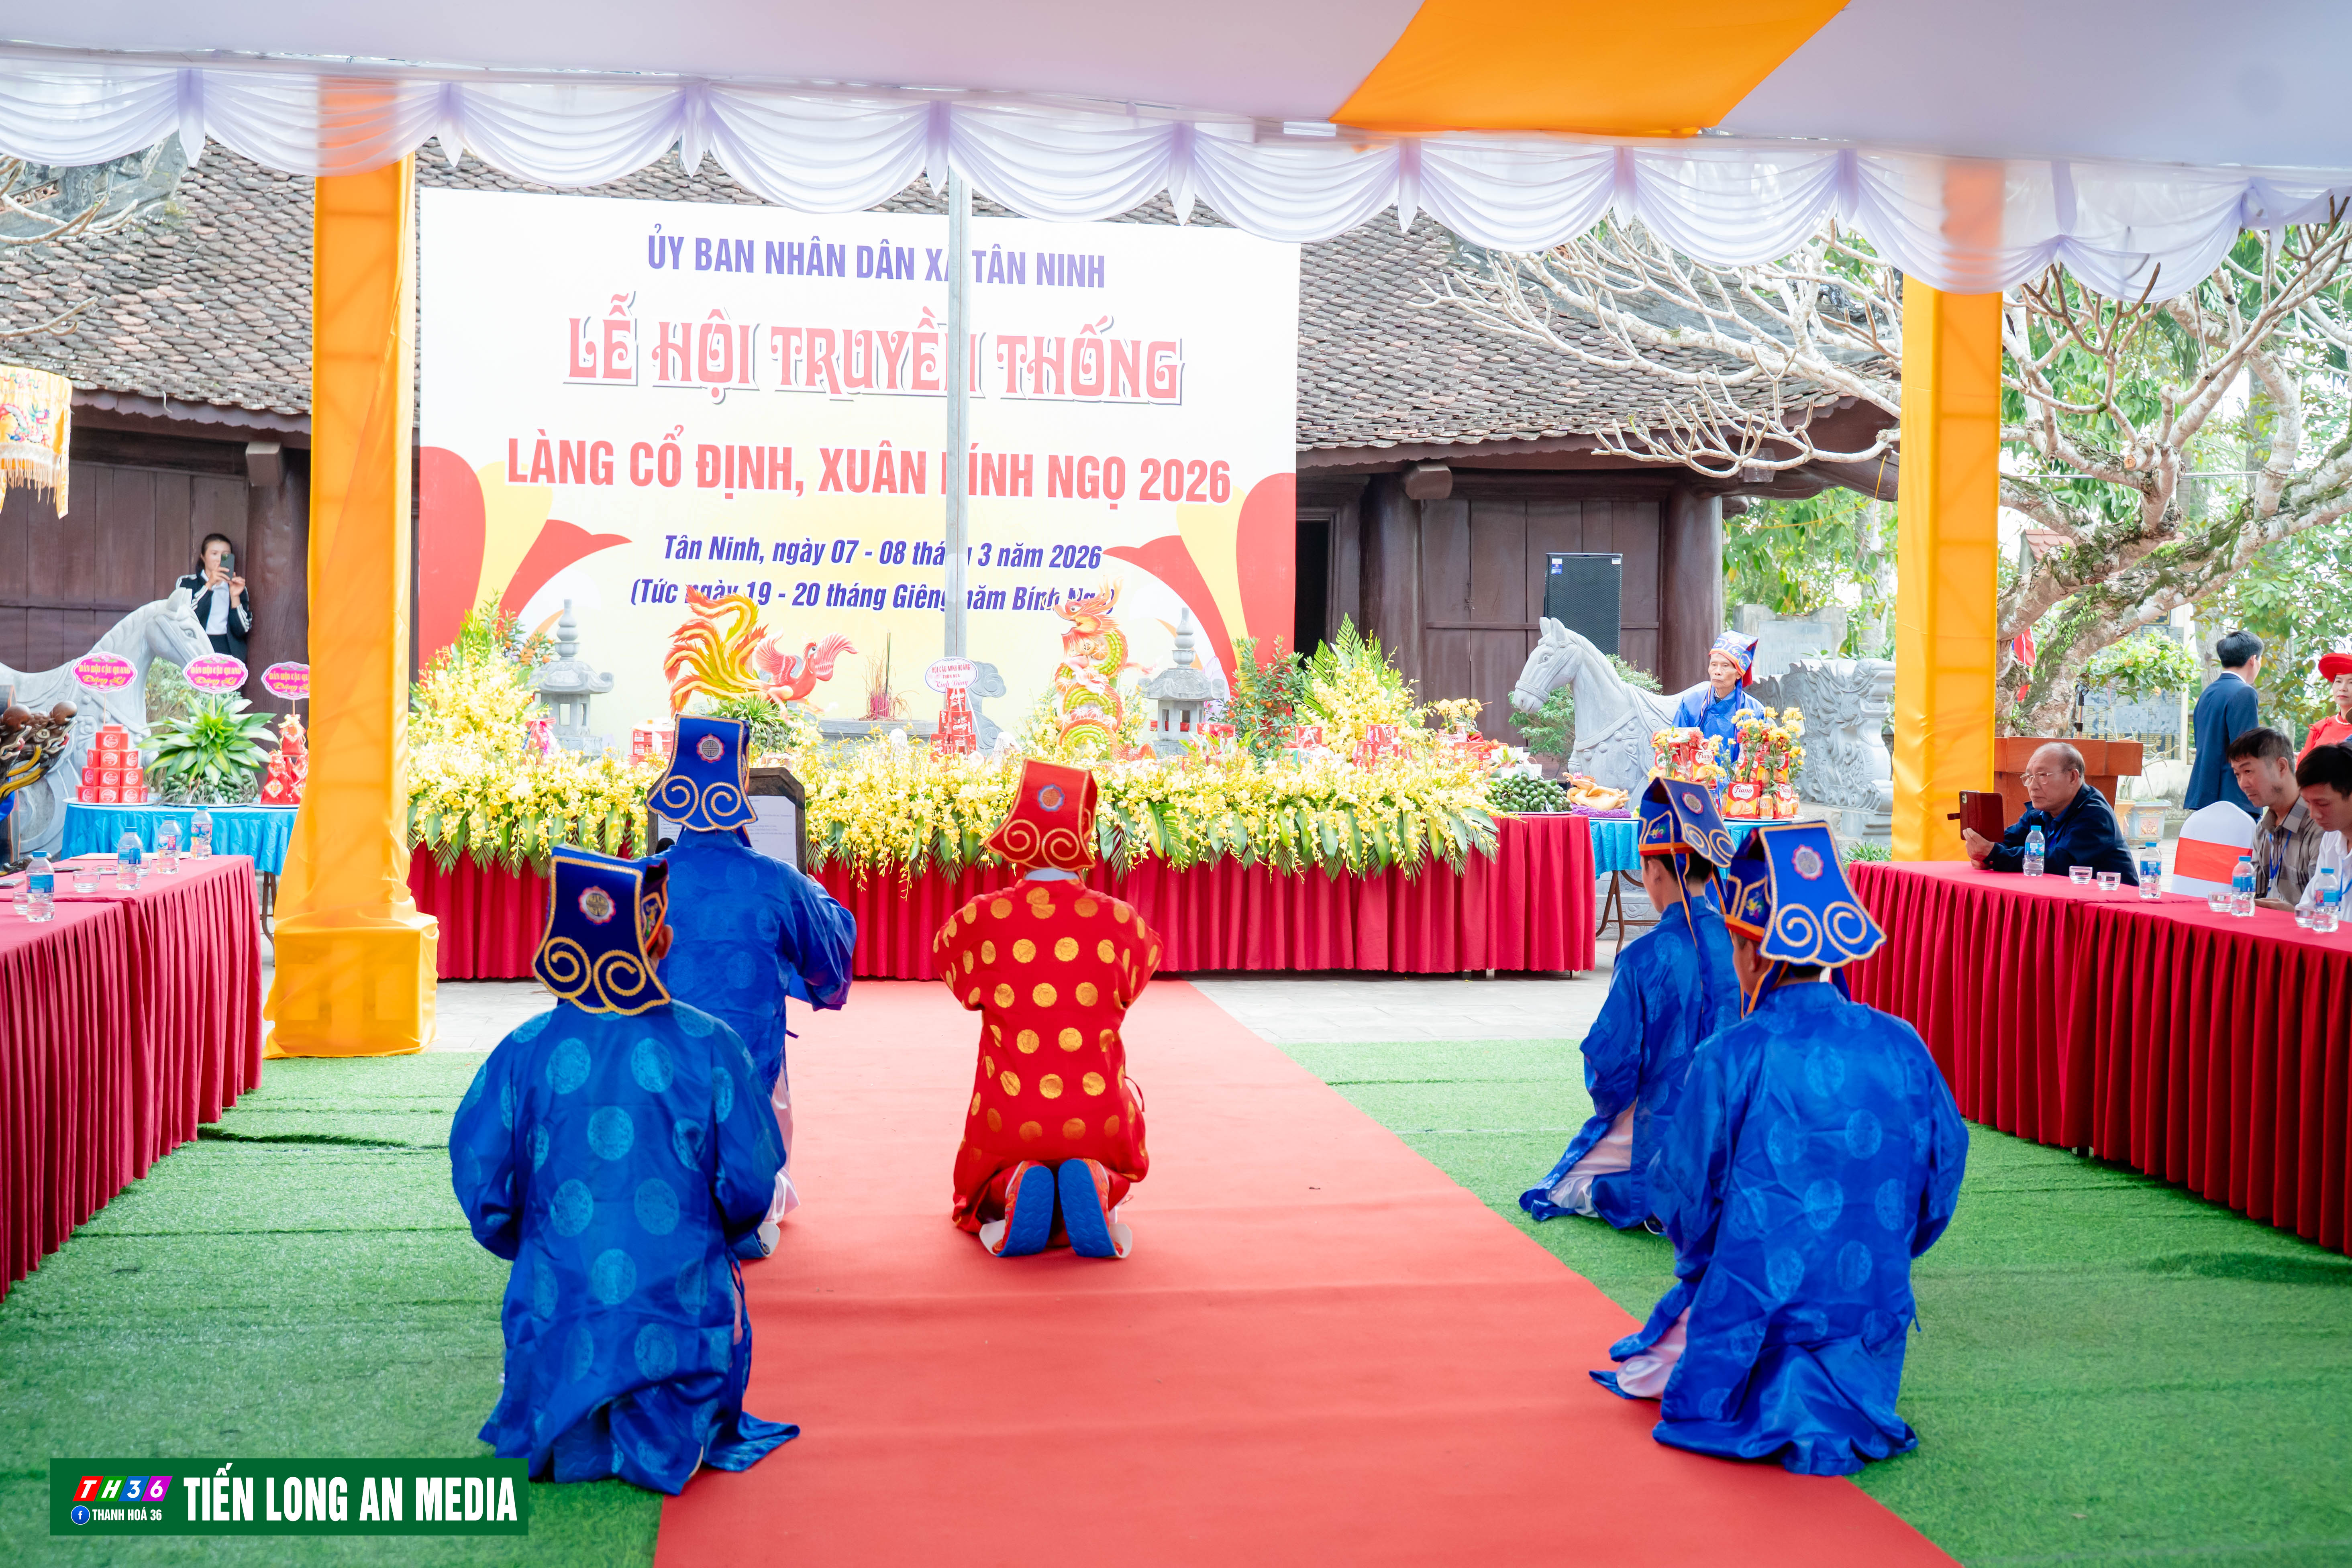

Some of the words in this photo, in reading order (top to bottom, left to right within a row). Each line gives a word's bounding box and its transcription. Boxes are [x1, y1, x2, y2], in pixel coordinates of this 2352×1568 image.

[648, 223, 684, 270] ỦY
[695, 237, 754, 273] BAN
[765, 235, 846, 277] NHÂN
[857, 239, 914, 280] DÂN
[924, 248, 949, 281] X
[972, 243, 1026, 285] TÂN
[1036, 252, 1104, 288] NINH
[566, 292, 635, 382] LỄ
[651, 308, 753, 400] HỘI
[997, 314, 1181, 398] THỐNG
[508, 428, 614, 485] LÀNG
[630, 424, 684, 487] CỔ
[696, 444, 804, 499] ĐỊNH,
[818, 440, 926, 494] XUÂN
[941, 442, 1033, 497] ÍNH
[1047, 455, 1126, 510] NGỌ
[1139, 458, 1230, 503] 2026
[665, 534, 703, 559] Tân
[708, 536, 765, 564] Ninh,
[772, 538, 826, 566] ngày
[830, 539, 860, 563] 07
[879, 540, 907, 565] 08
[912, 541, 972, 567] thá
[978, 542, 992, 567] 3
[997, 542, 1044, 567] năm
[1049, 545, 1102, 569] 2026
[631, 579, 678, 606] (Tức
[747, 581, 772, 606] 19
[791, 582, 820, 606] 20
[827, 582, 886, 611] tháng
[1012, 585, 1060, 611] Bính
[1697, 751, 1712, 759] Fiano
[1734, 785, 1752, 794] Fiano
[1781, 785, 1791, 794] Fiano
